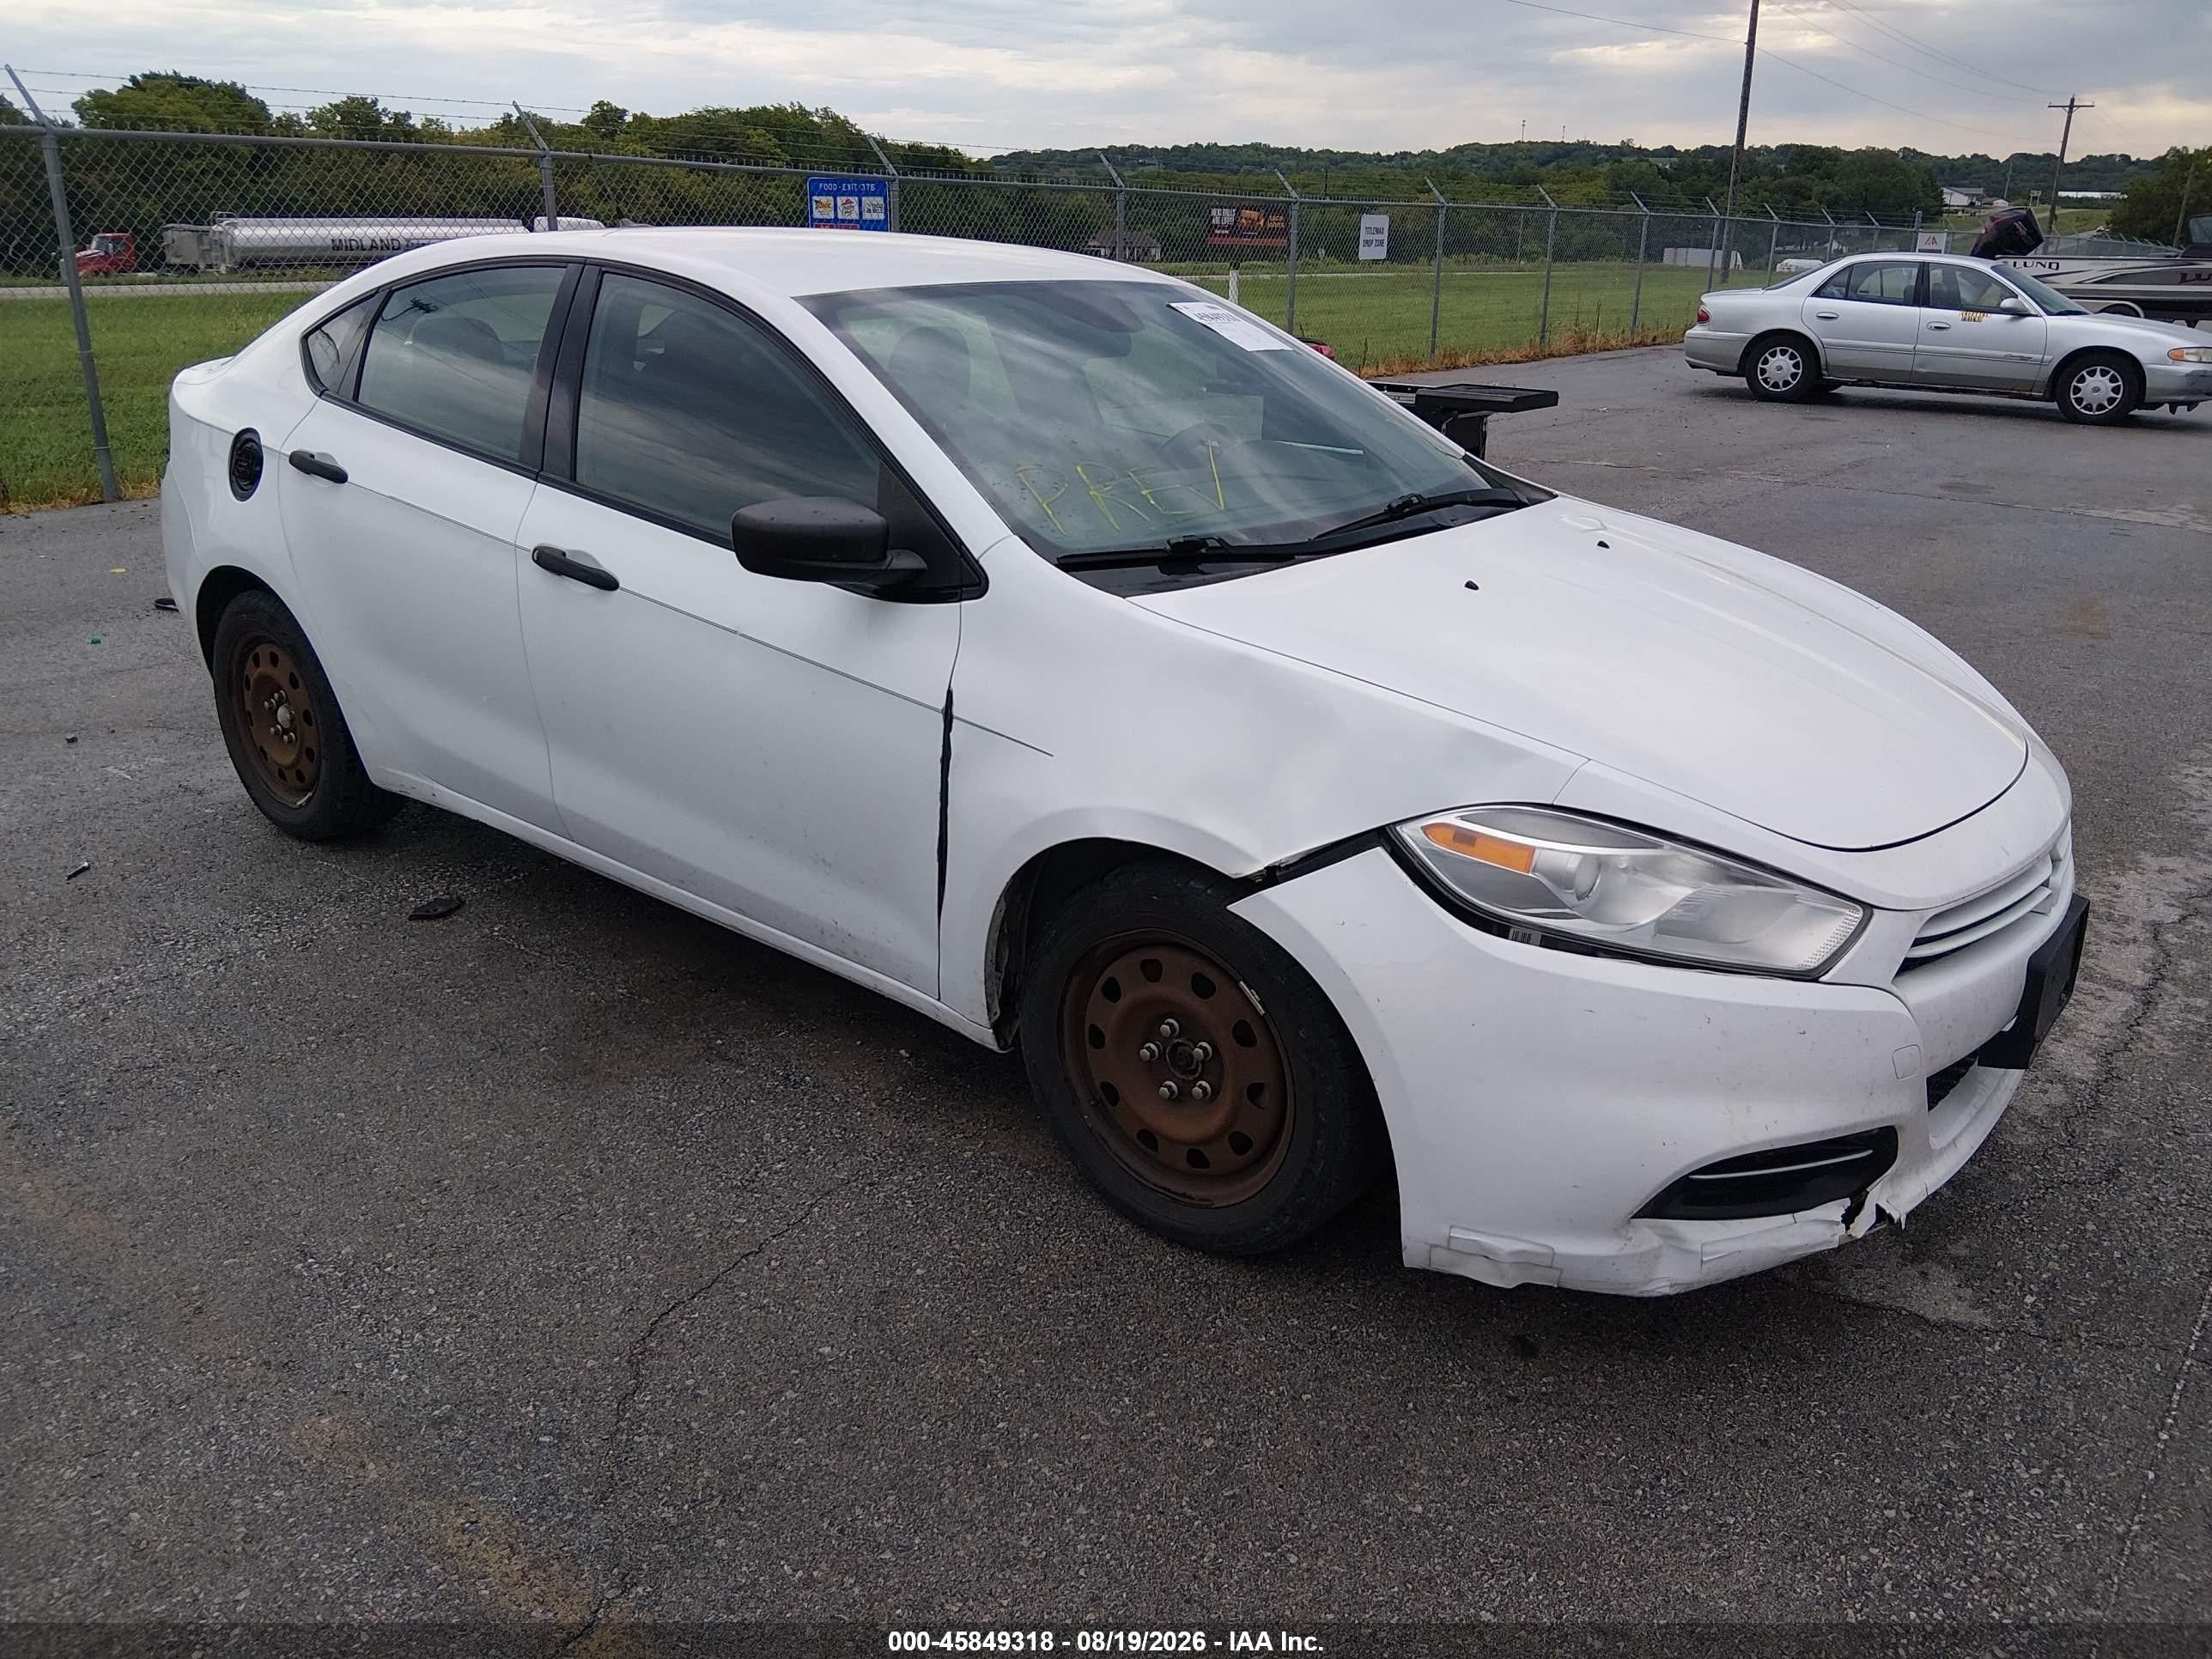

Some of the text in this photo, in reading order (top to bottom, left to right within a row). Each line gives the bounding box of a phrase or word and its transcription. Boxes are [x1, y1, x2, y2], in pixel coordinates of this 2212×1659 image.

[331, 239, 402, 251] MIDLAND
[1363, 239, 1385, 247] DROP ZONE
[2013, 260, 2060, 270] LUND
